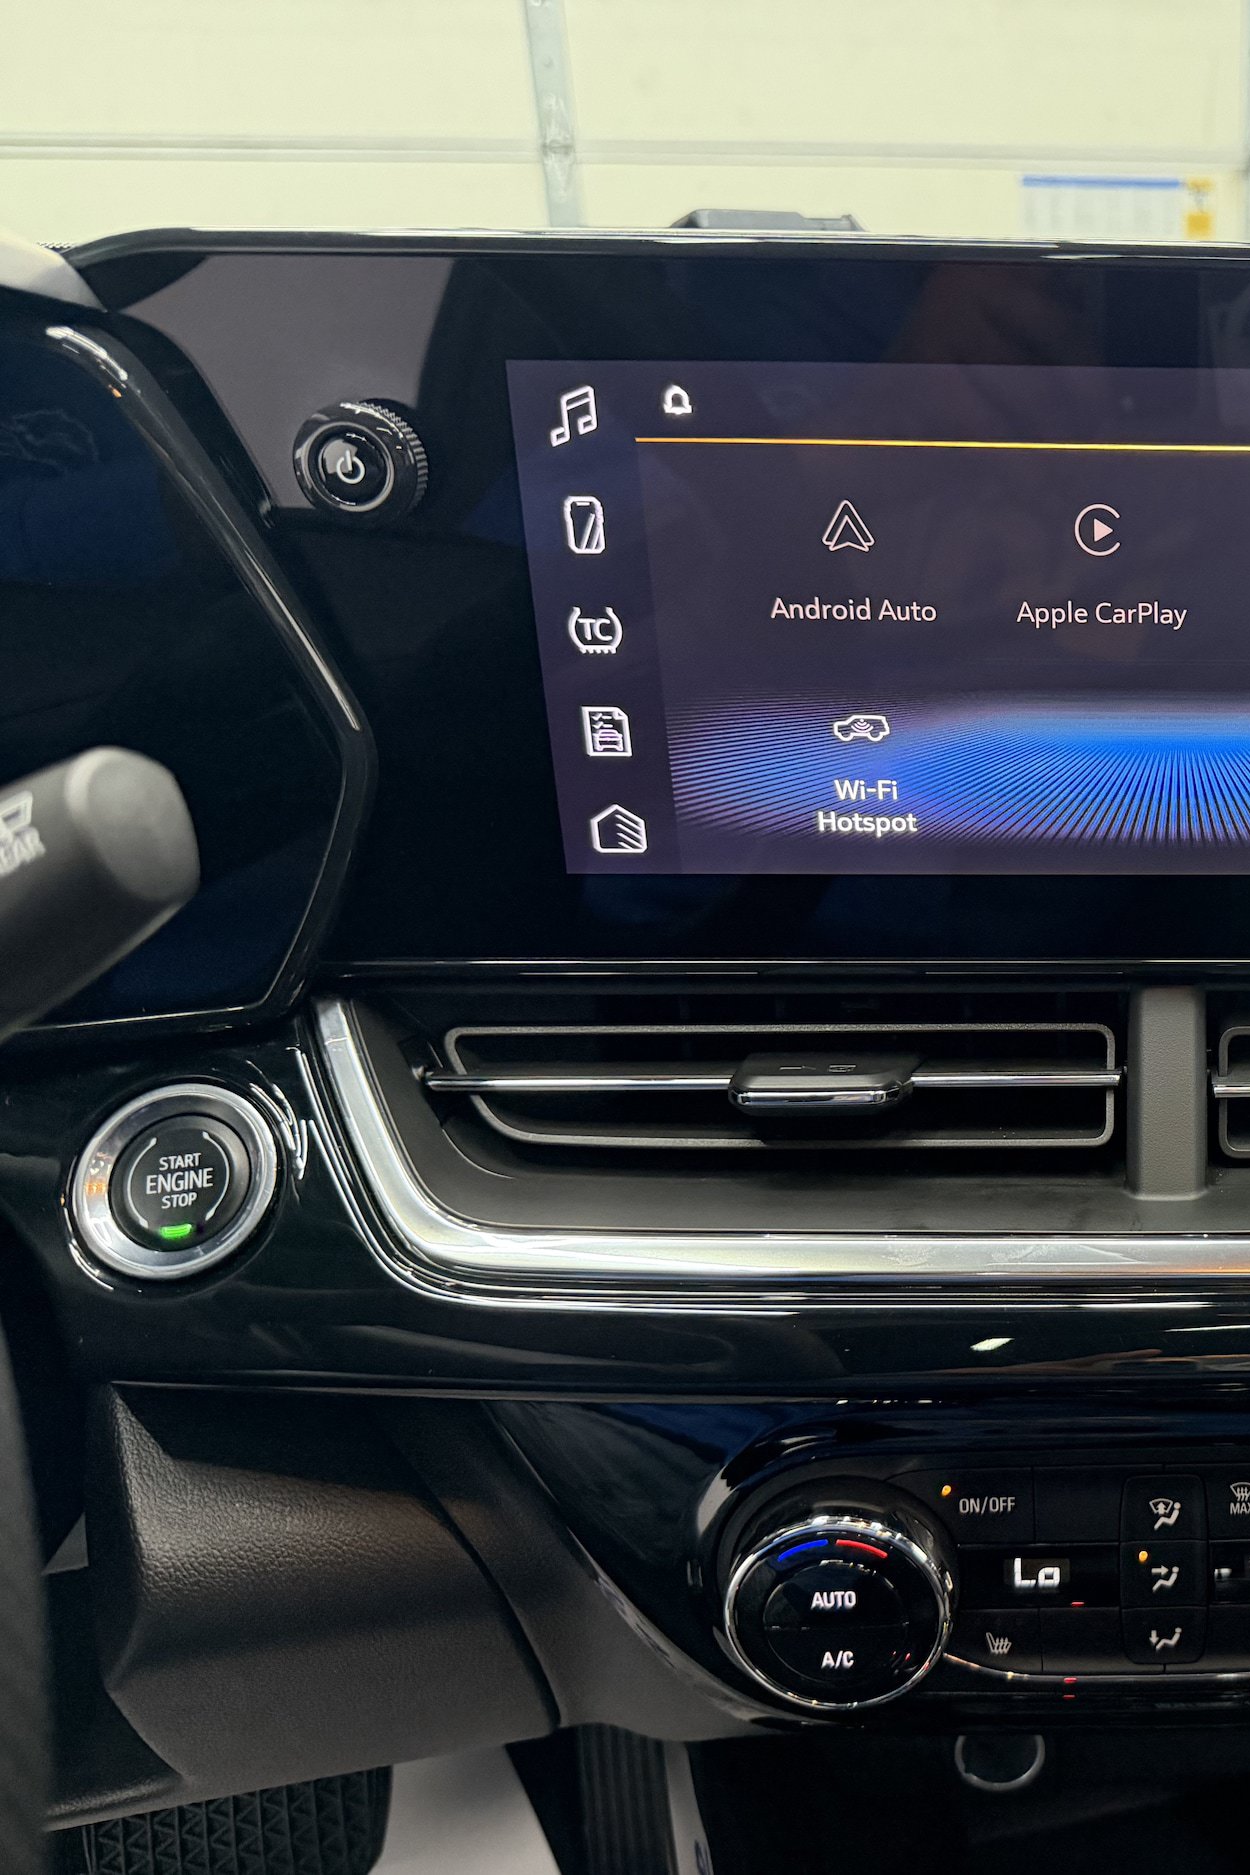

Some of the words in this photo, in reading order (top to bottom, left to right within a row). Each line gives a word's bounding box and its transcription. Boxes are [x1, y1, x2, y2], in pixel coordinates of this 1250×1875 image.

[771, 597, 870, 622] Android
[878, 599, 937, 623] Auto
[1016, 602, 1088, 627] Apple
[1094, 602, 1187, 630] CarPlay
[578, 617, 613, 641] TC
[834, 780, 898, 801] Wi-Fi
[817, 812, 917, 835] Hotspot
[159, 1153, 201, 1171] START
[146, 1168, 214, 1194] ENGINE
[161, 1192, 197, 1209] STOP
[958, 1496, 1016, 1514] ON/OFF
[811, 1590, 857, 1609] AUTO
[821, 1651, 855, 1669] A/C
